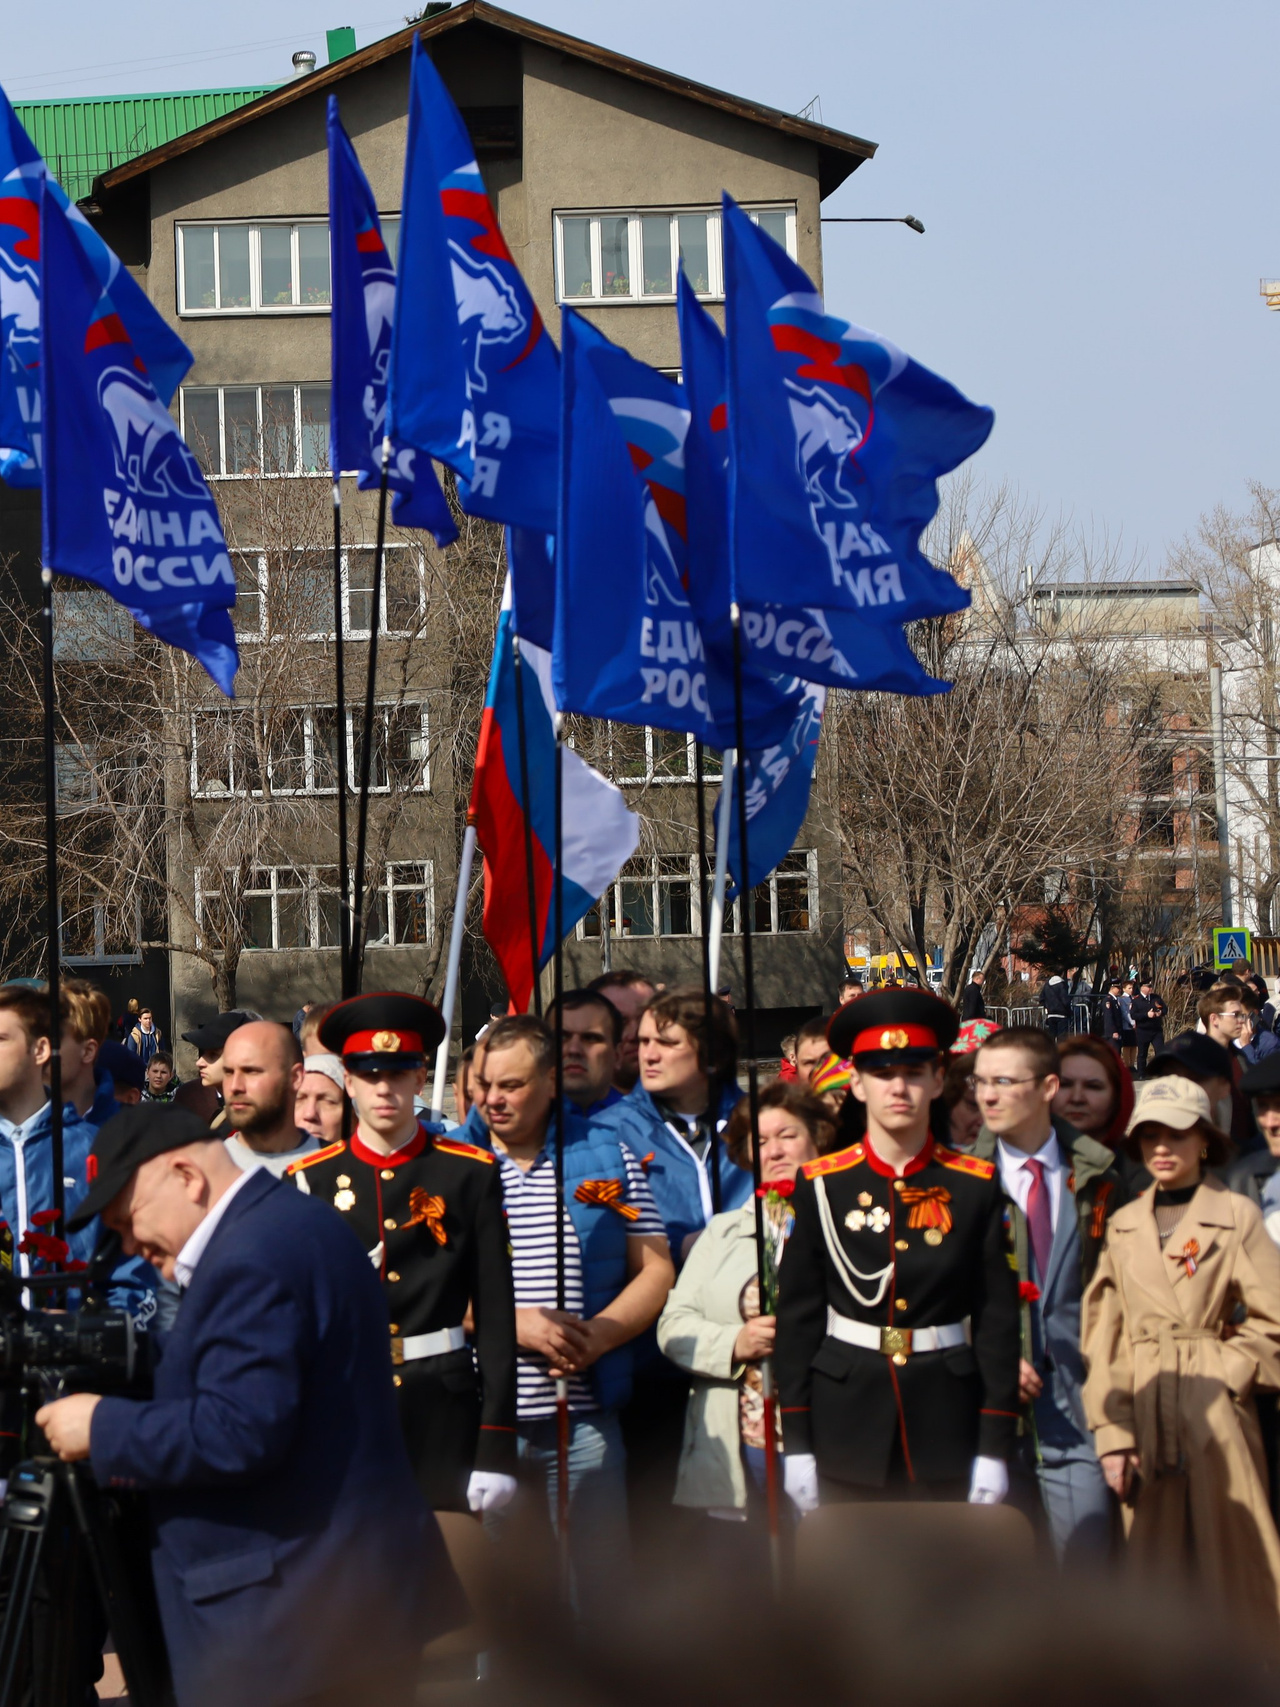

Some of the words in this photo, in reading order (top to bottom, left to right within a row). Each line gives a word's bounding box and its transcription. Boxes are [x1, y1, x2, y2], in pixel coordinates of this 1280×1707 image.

[103, 487, 225, 547] ЕДИНА
[111, 545, 236, 592] ОССИ
[640, 616, 706, 665] ЕДИ
